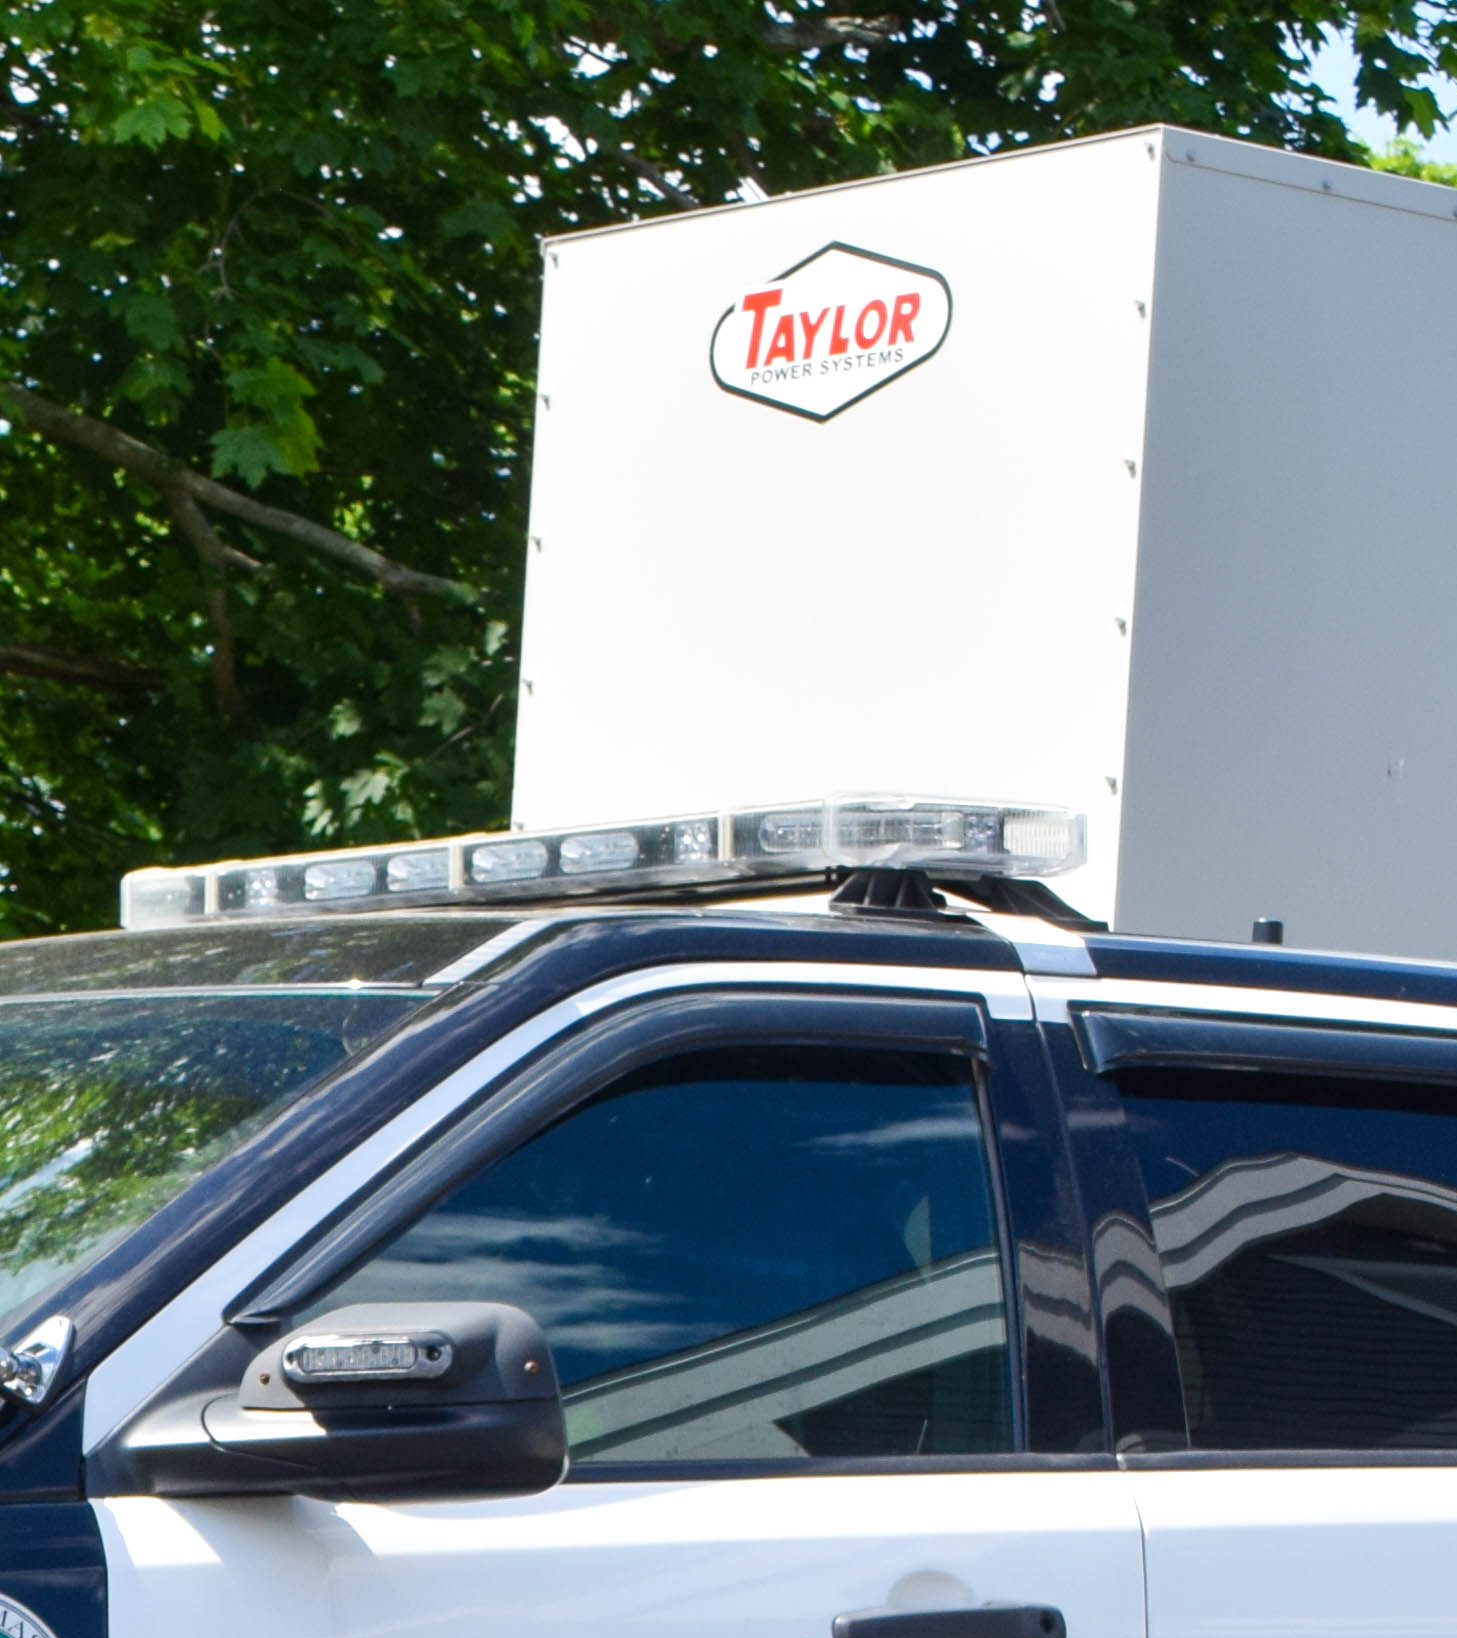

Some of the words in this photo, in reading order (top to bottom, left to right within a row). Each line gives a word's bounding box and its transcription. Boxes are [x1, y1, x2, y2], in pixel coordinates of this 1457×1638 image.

[742, 288, 921, 369] TAYLOR
[750, 363, 813, 385] POWER
[819, 348, 905, 376] SYSTEMS
